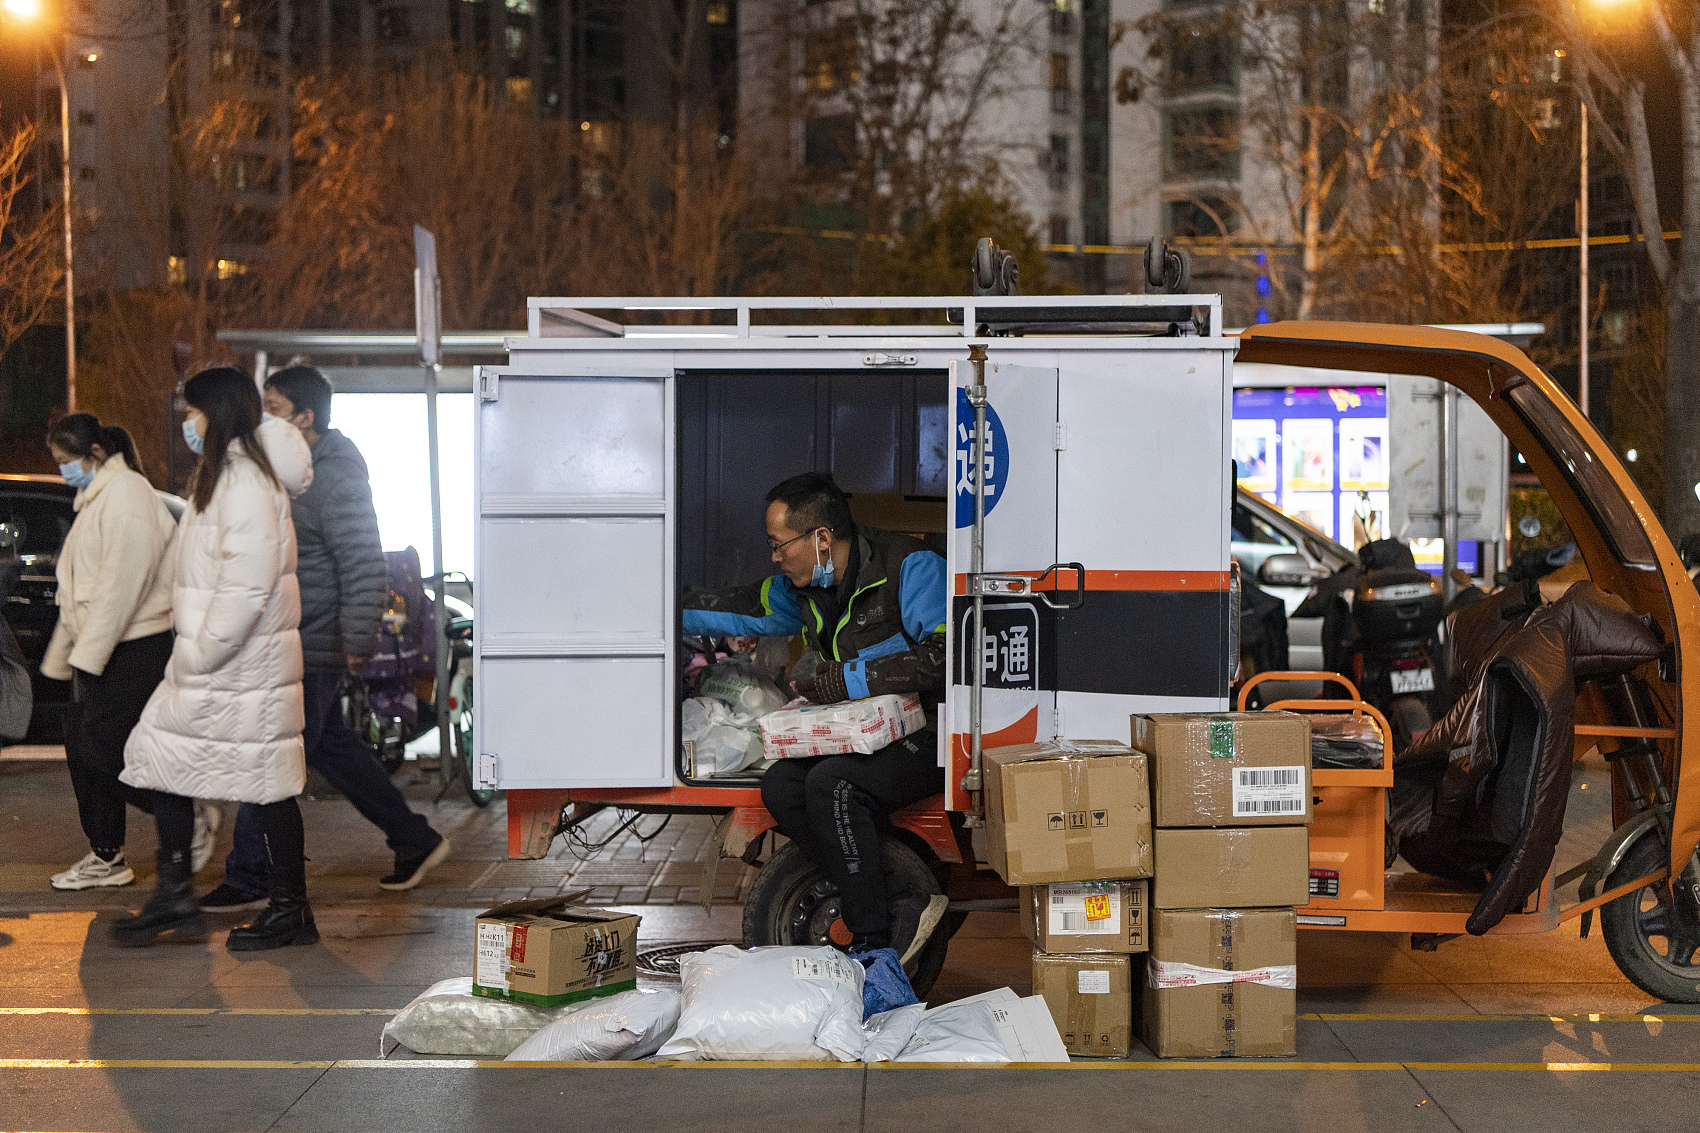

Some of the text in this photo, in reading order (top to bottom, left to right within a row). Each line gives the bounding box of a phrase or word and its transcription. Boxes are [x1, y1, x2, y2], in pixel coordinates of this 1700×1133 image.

[833, 800, 841, 819] MIND
[839, 836, 850, 855] BODY
[845, 825, 859, 856] HEALTHY
